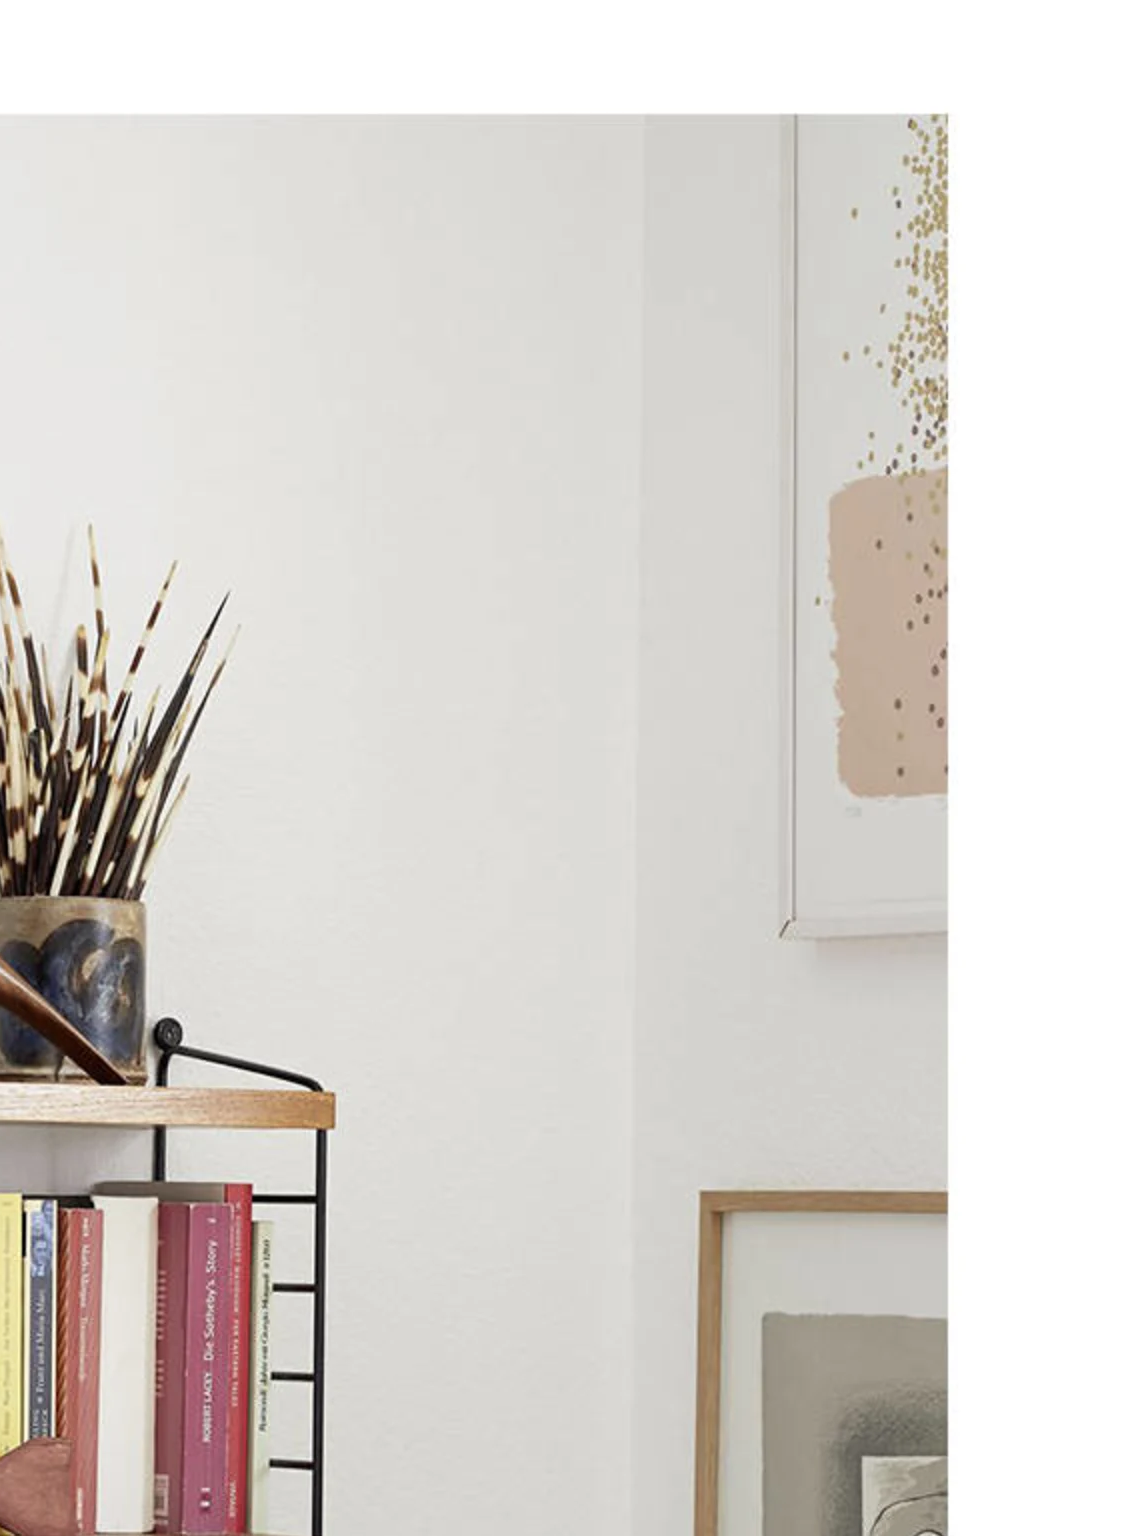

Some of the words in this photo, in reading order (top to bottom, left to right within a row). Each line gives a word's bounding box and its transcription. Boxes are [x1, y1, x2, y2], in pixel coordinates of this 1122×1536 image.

[206, 1240, 218, 1273] Story
[204, 1279, 218, 1338] Sotheby's
[204, 1342, 214, 1361] Die
